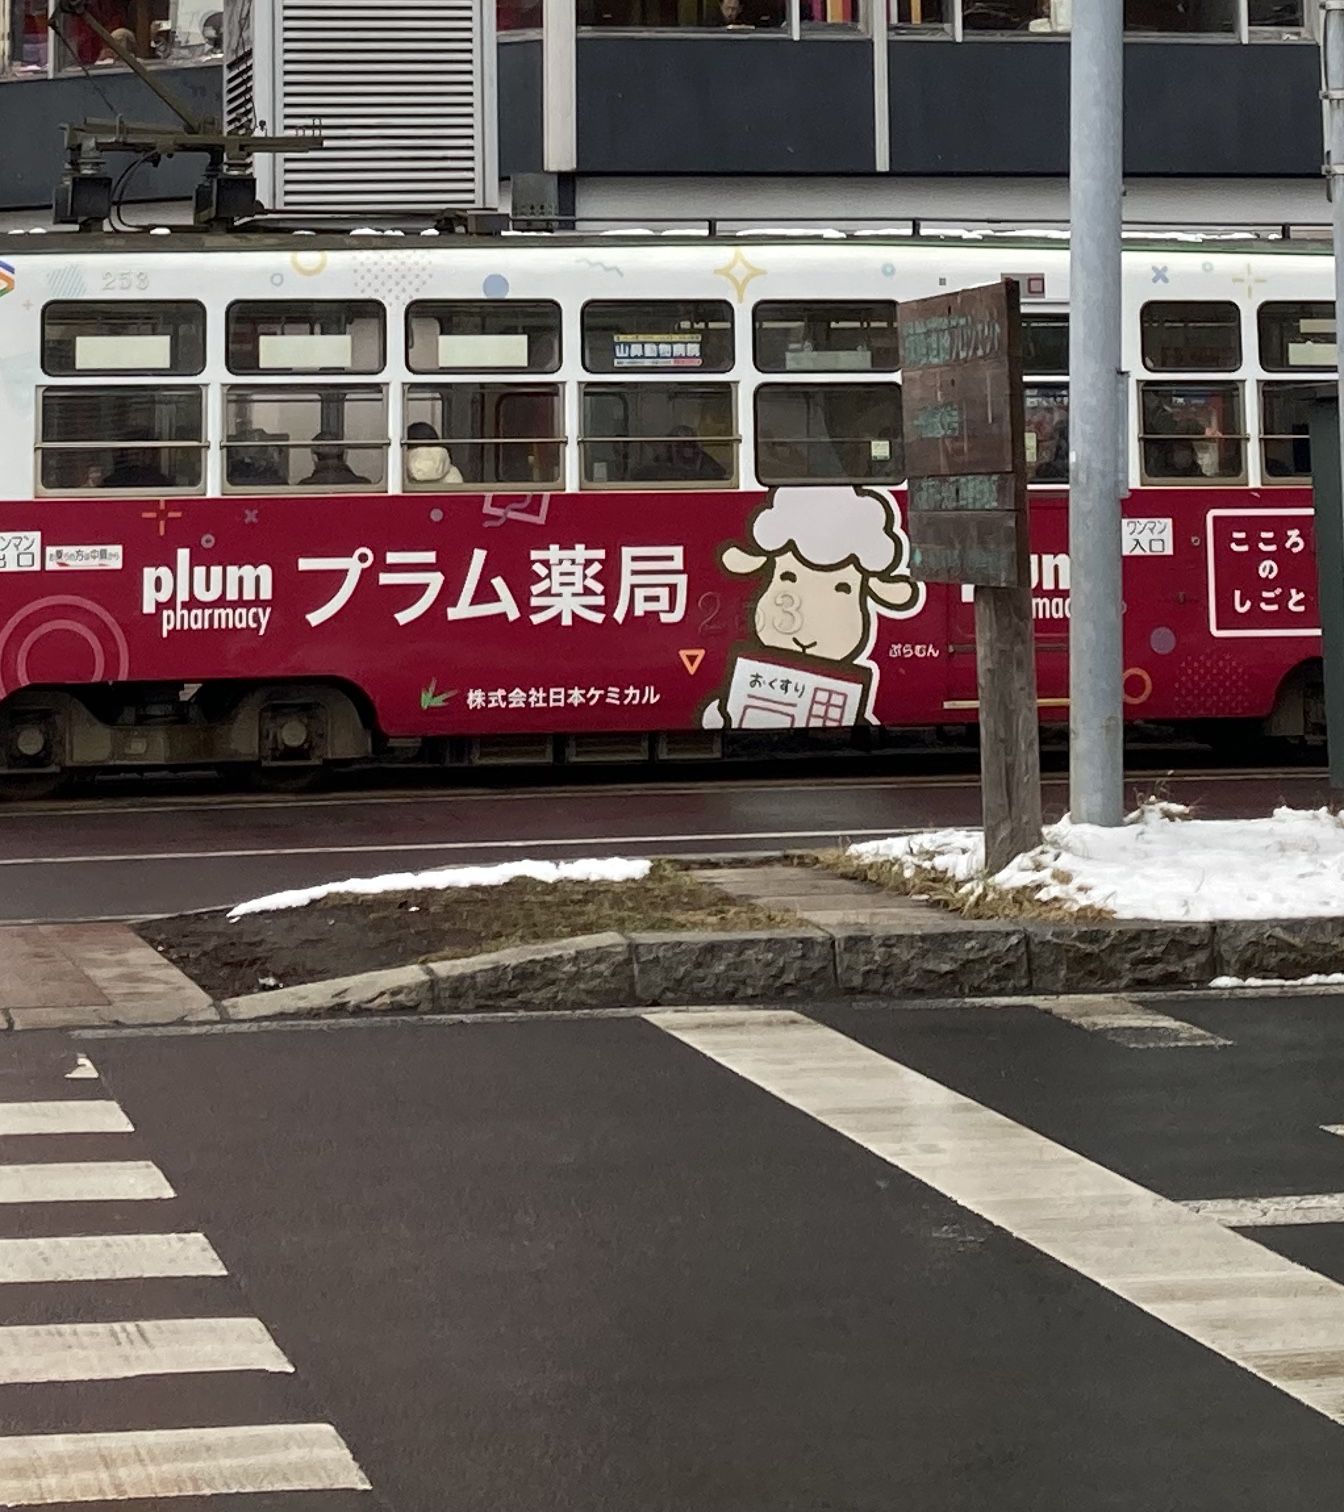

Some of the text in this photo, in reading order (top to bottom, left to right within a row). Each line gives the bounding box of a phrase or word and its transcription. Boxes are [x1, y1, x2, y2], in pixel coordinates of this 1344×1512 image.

[1126, 521, 1167, 535] ワンマン
[1229, 528, 1306, 553] こころ
[1128, 538, 1166, 553] 入口
[142, 547, 273, 616] plum
[1258, 559, 1279, 580] の
[296, 543, 689, 627] プラム薬局
[1233, 587, 1306, 614] しごと
[161, 594, 272, 638] pharmacy
[465, 685, 661, 710] 株式会社日本ケミカル
[748, 672, 807, 699] おくすり
